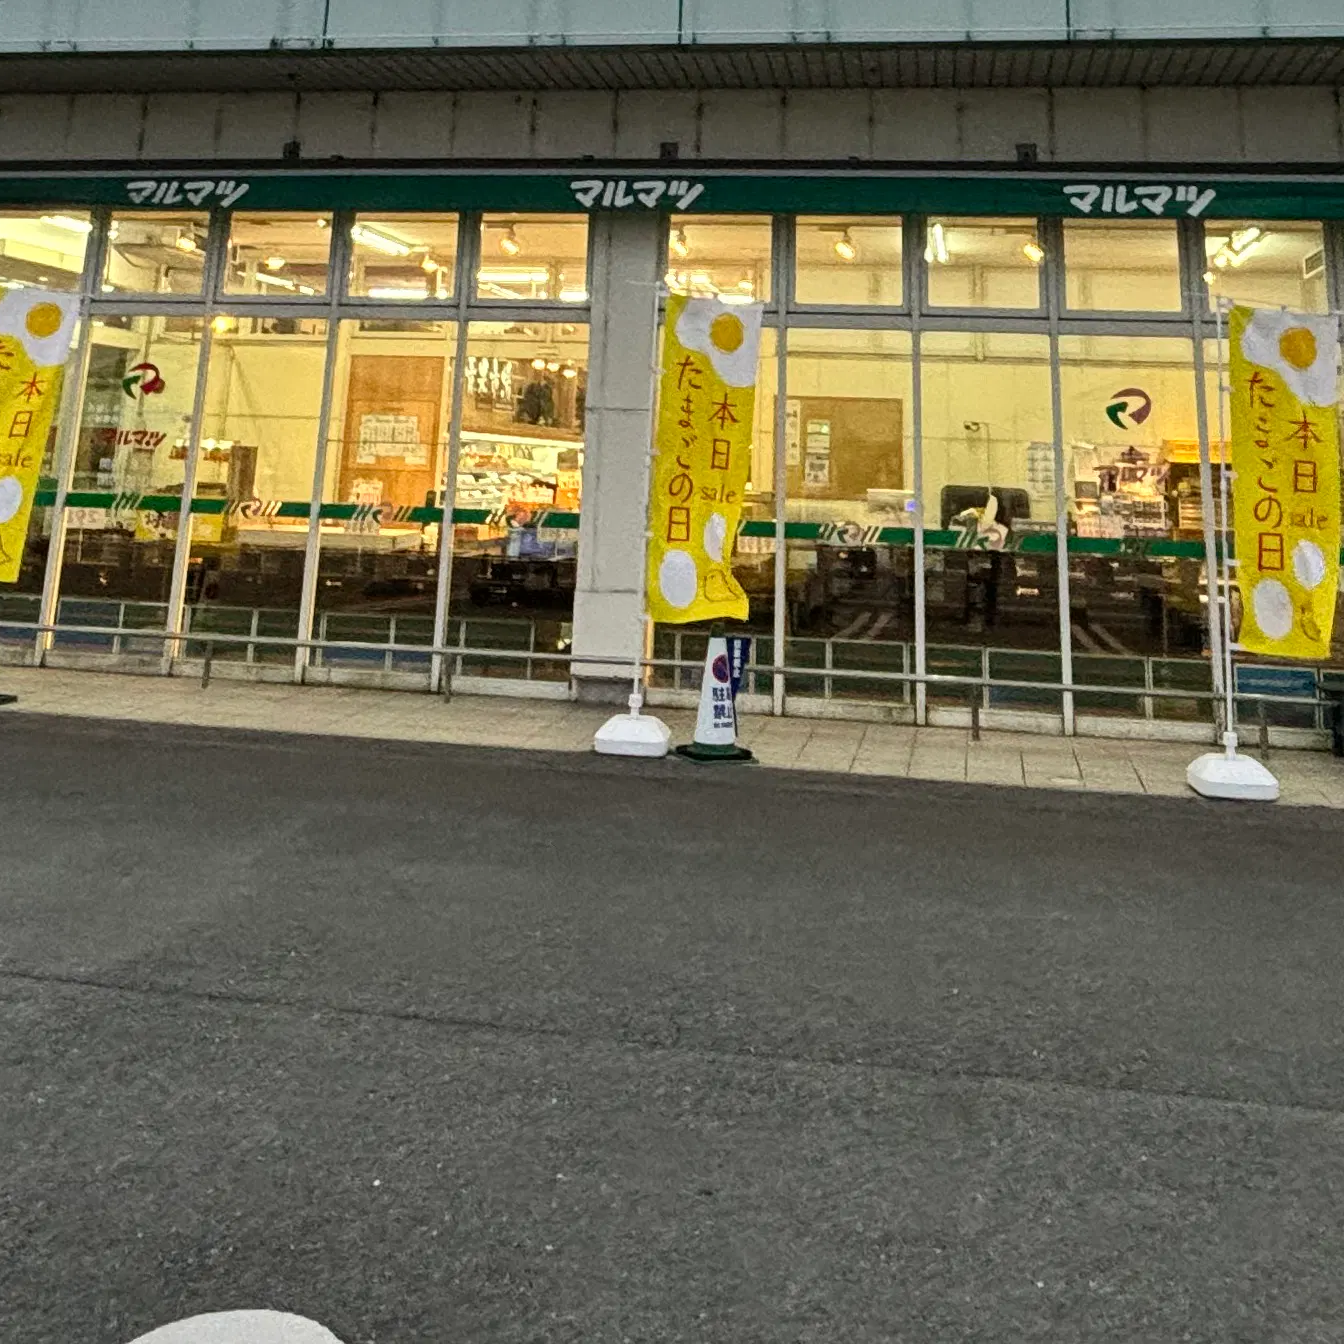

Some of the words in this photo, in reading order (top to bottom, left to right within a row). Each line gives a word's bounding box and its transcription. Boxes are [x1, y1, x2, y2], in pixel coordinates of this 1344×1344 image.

[126, 179, 250, 208] マルマツ
[570, 179, 705, 210] マルマツ
[1062, 183, 1218, 217] マルマツ
[8, 372, 46, 440] 本日
[666, 355, 703, 544] たまごの日
[708, 393, 740, 471] 本日
[1282, 409, 1323, 494] 本日
[699, 483, 738, 505] sale
